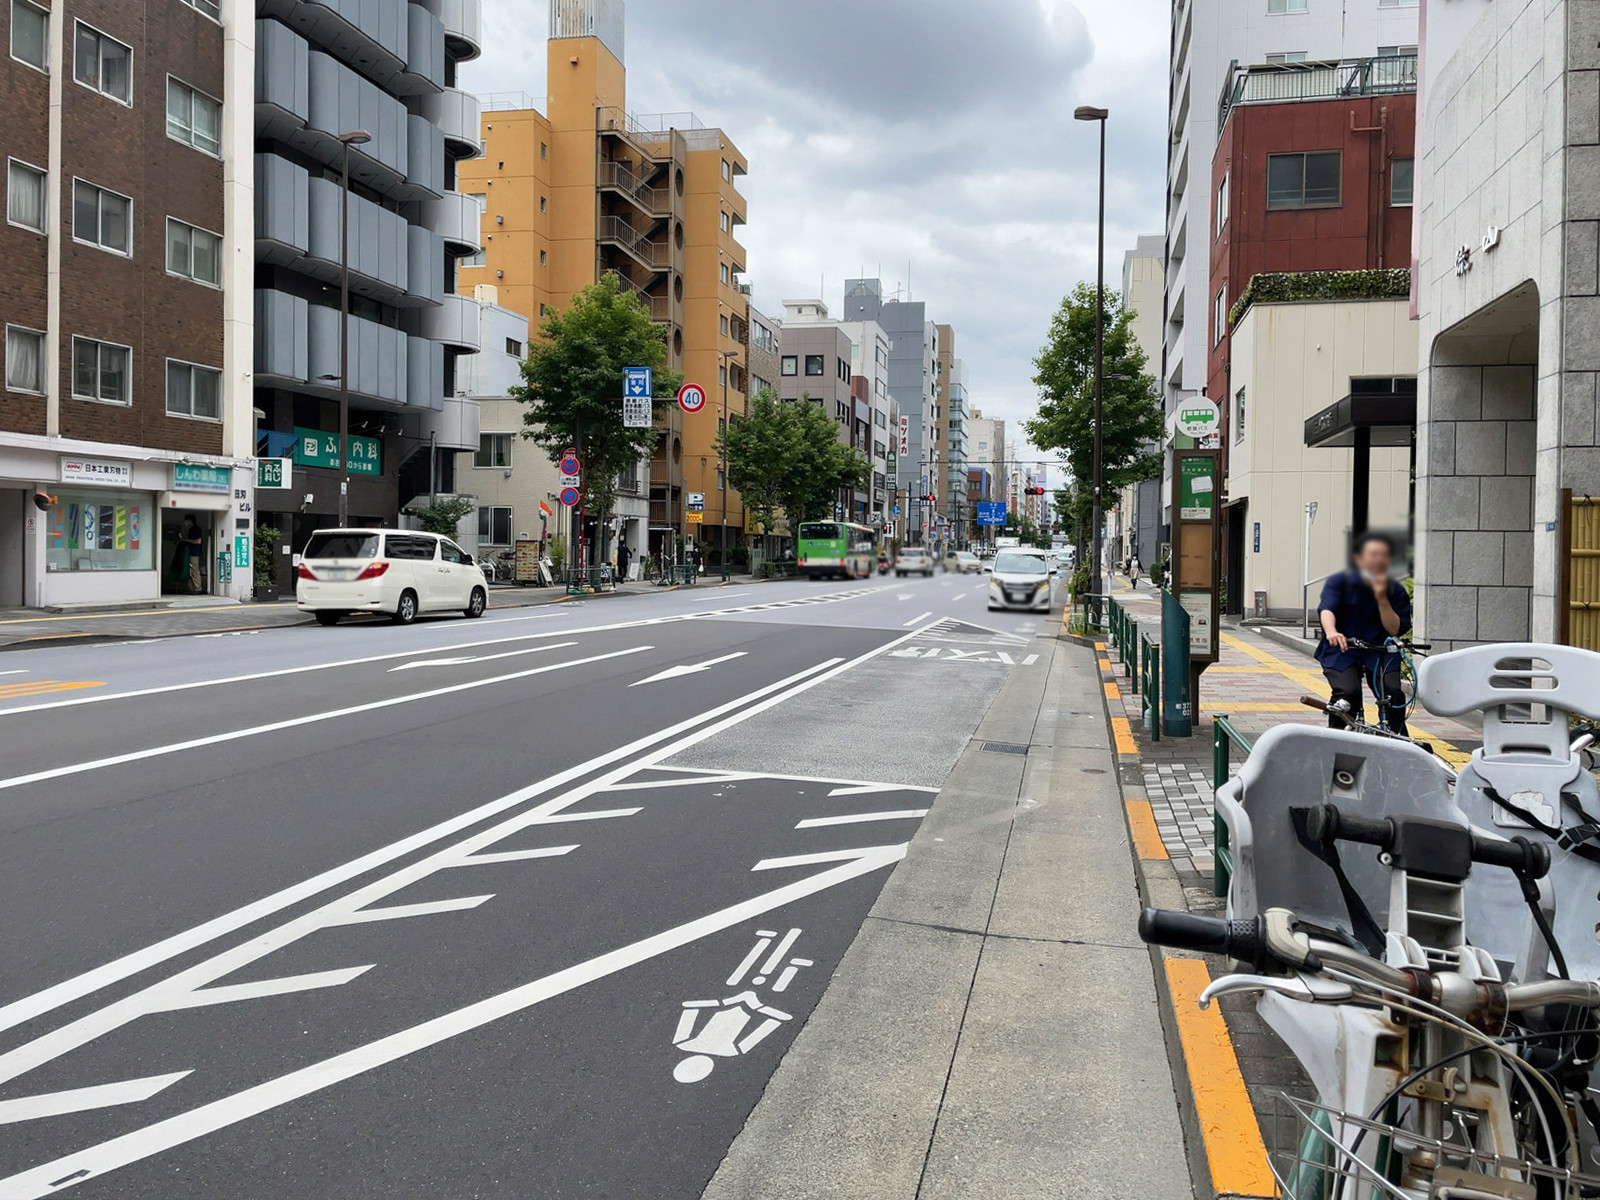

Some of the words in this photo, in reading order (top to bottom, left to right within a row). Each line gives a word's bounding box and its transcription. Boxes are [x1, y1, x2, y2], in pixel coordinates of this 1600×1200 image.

[685, 392, 700, 405] 40
[325, 436, 377, 460] ふ内科
[85, 464, 121, 475] 日本工業刃物
[234, 489, 246, 499] 日刃
[239, 502, 251, 512] ビル
